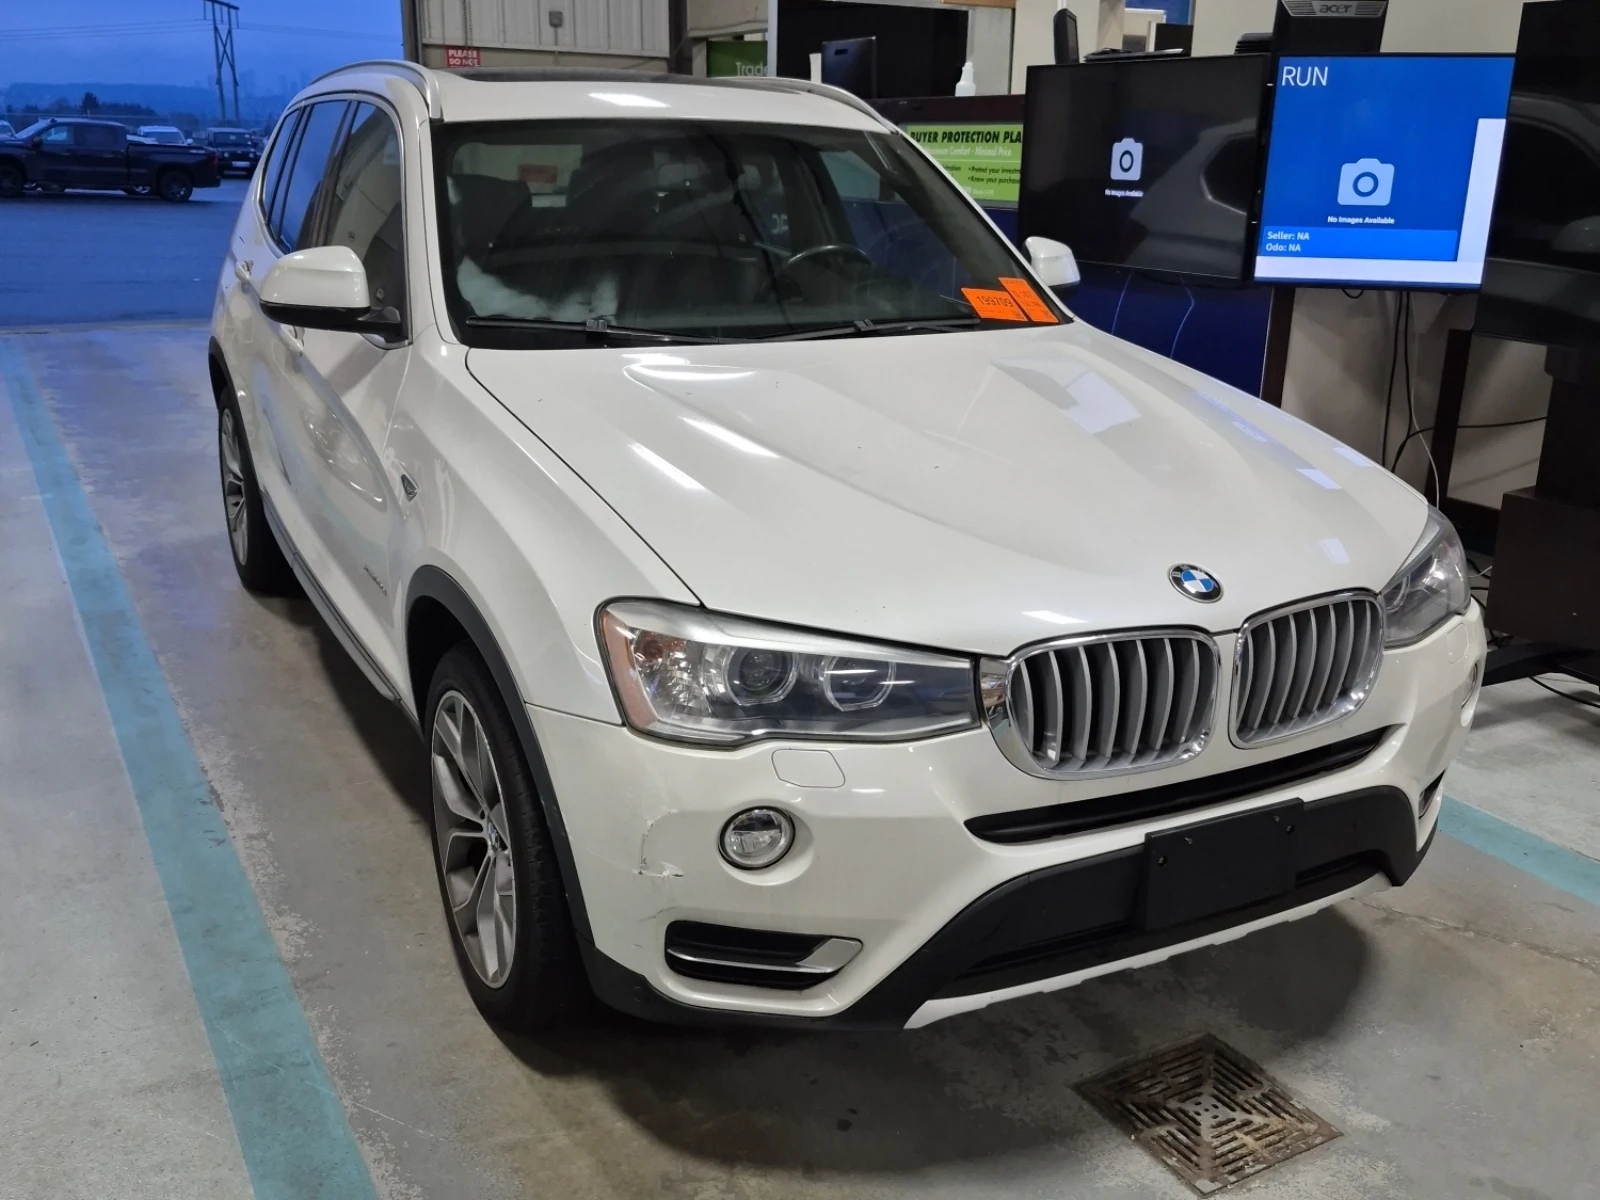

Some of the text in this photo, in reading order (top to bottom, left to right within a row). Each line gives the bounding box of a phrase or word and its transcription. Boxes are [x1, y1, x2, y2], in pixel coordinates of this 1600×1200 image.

[1319, 4, 1353, 13] acer
[448, 49, 478, 58] PLEASE
[462, 58, 478, 66] NOT
[1281, 66, 1329, 87] RUN
[941, 130, 1000, 143] PROTECTION
[988, 167, 1000, 175] your
[1338, 216, 1363, 224] Images
[1364, 216, 1395, 224] Available
[1267, 231, 1310, 240] Seller: NA
[1265, 243, 1302, 252] Odo: NA
